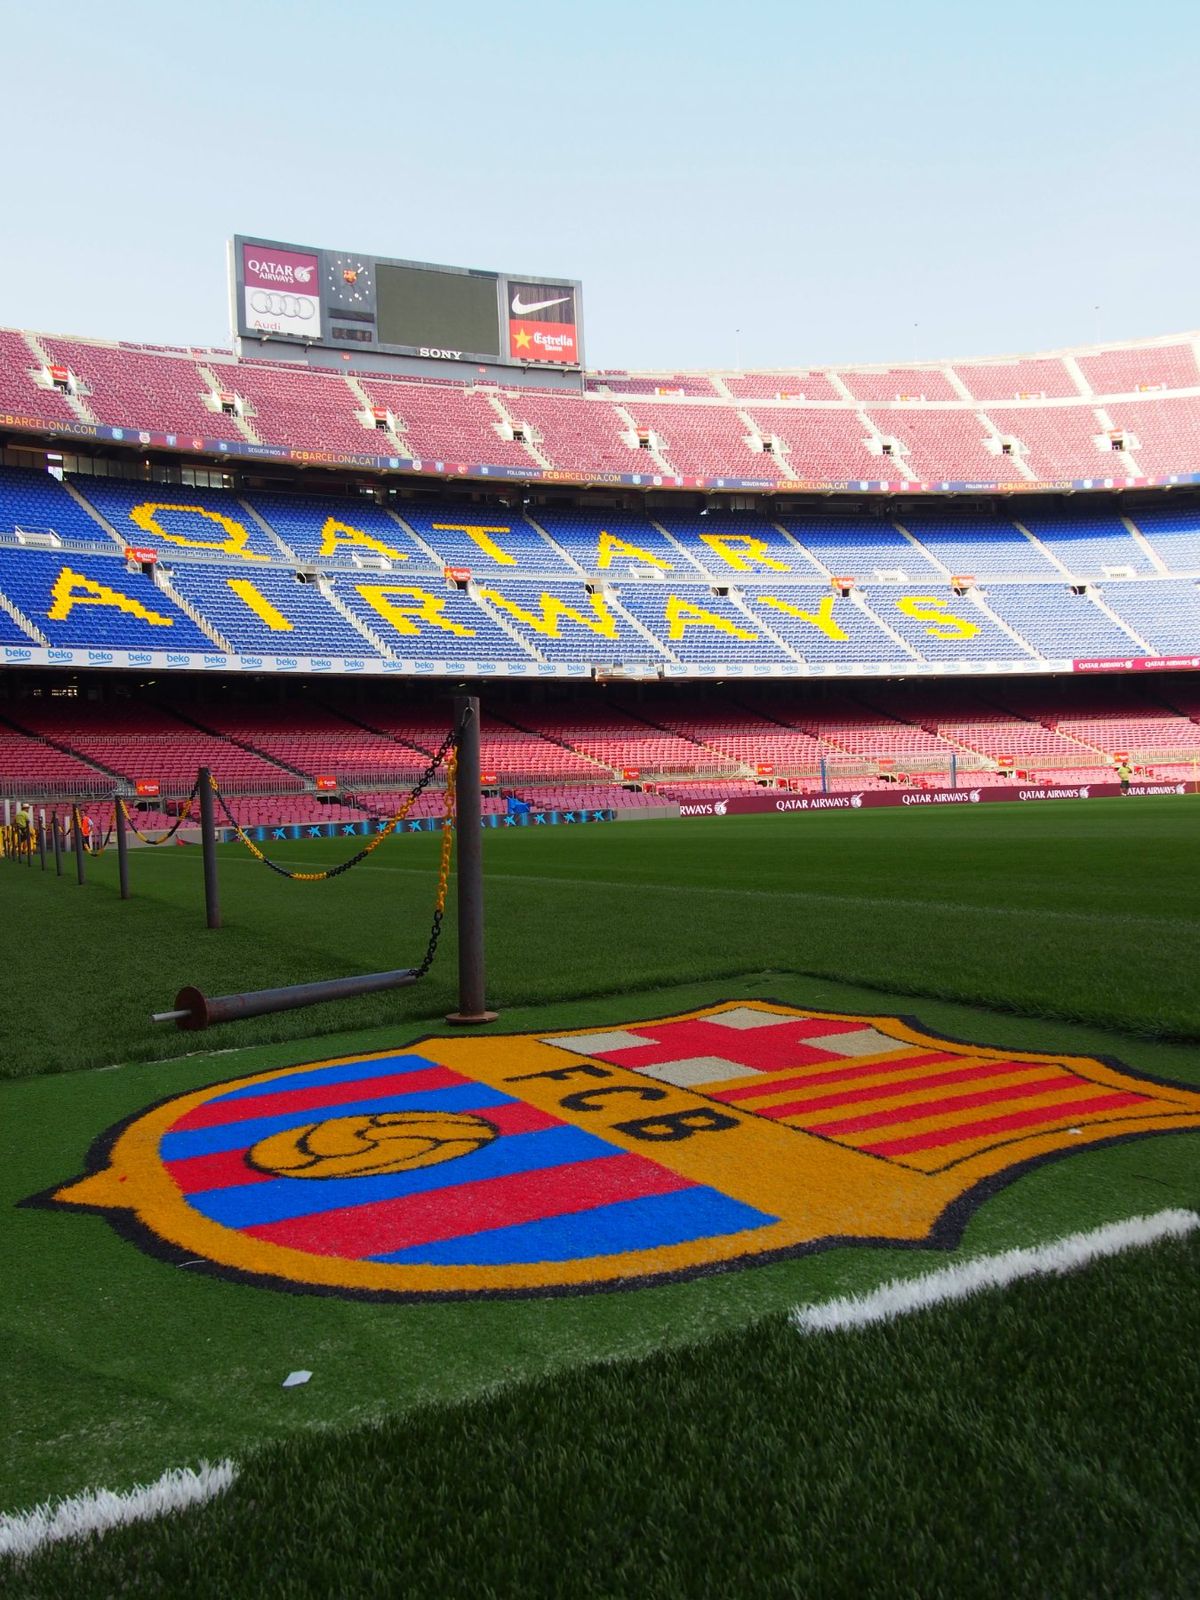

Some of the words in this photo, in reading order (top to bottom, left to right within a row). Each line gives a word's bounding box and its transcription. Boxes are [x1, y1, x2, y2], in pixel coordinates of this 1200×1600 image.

[248, 260, 293, 276] QATAR
[259, 272, 294, 283] AIRWAYS
[254, 320, 281, 331] Audi
[533, 331, 573, 347] Estrella
[419, 347, 462, 360] SONY
[290, 450, 375, 465] FCBARCELONA.CAT
[542, 470, 622, 482] FCBARCELONA.COM
[776, 481, 849, 490] FCBARCELONA.CAT
[997, 482, 1073, 490] FCBARCELONA.COM
[130, 502, 791, 571] QATAR
[48, 566, 981, 642] AIRWAYS
[5, 648, 32, 657] beko
[48, 649, 73, 659] beko
[88, 651, 113, 660] beko
[128, 653, 152, 662] beko
[166, 654, 190, 663] beko
[204, 656, 227, 664] beko
[240, 656, 262, 665] beko
[276, 658, 297, 666] beko
[311, 659, 332, 667] beko
[344, 659, 364, 668] beko
[382, 660, 402, 668] beko
[415, 661, 434, 669] beko
[446, 662, 465, 670] beko
[507, 663, 527, 671] beko
[538, 663, 557, 671] beko
[567, 664, 585, 672] beko
[670, 664, 688, 672] beko
[698, 664, 716, 673] beko
[1019, 790, 1045, 800] QATAR
[1047, 788, 1078, 798] AIRWAYS
[1127, 786, 1146, 796] ATAR
[1148, 785, 1175, 794] AIRWAYS
[776, 800, 808, 811] QATAR
[810, 797, 849, 808] AIRWAYS
[902, 794, 931, 805] QATAR
[933, 792, 968, 802] AIRWAYS
[680, 804, 713, 815] RWAYS
[502, 1063, 741, 1143] FCB
